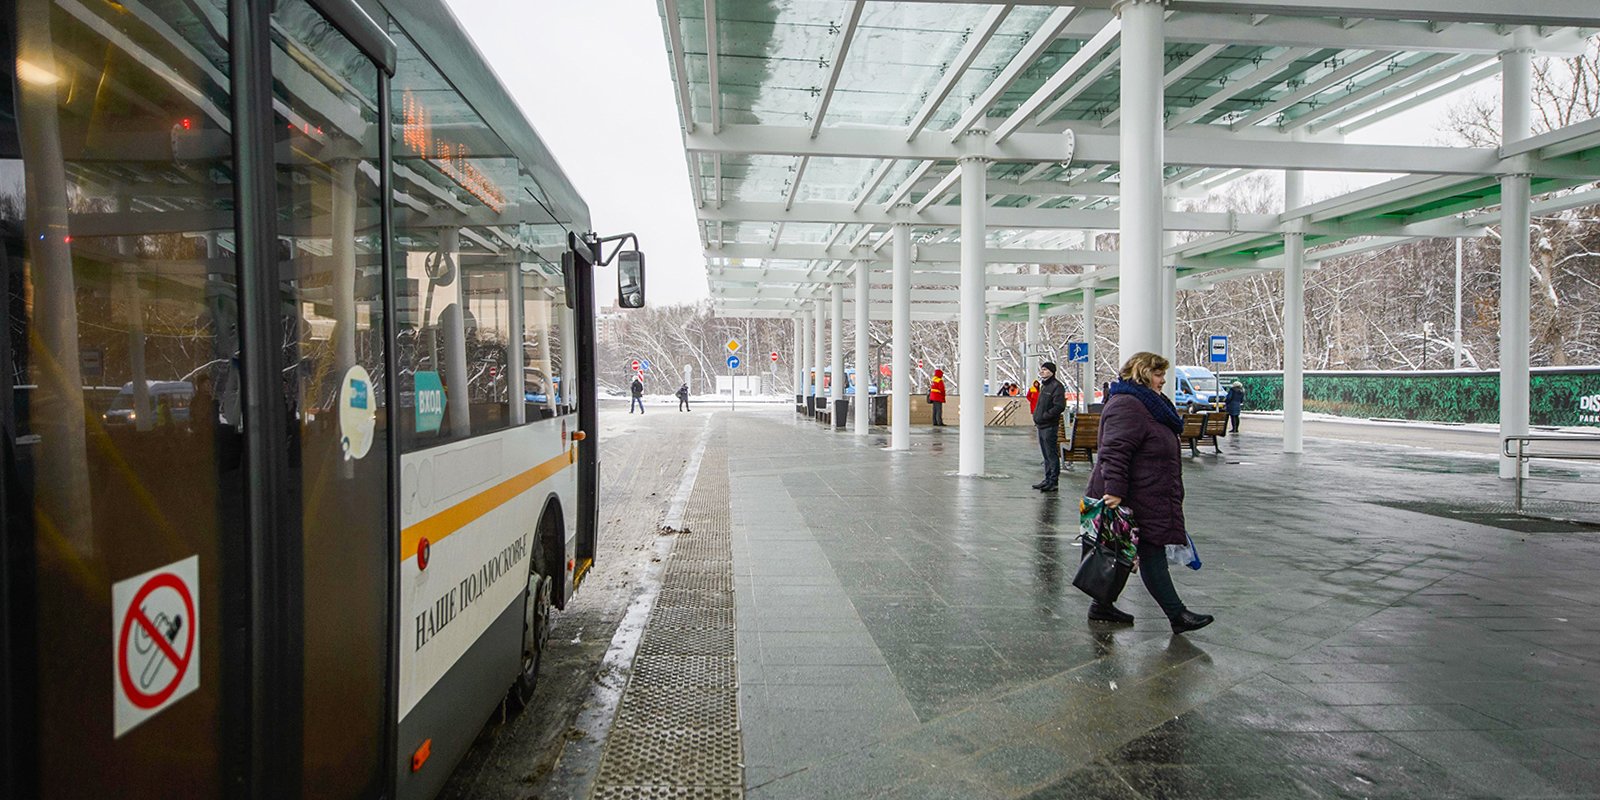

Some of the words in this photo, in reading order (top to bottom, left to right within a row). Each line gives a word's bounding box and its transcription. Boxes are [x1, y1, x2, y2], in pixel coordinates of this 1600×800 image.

[419, 389, 442, 415] ВХОД
[1579, 394, 1600, 413] DIS
[1579, 414, 1600, 423] PARK
[415, 586, 457, 652] НАШЕ
[459, 533, 528, 613] ПОДМОСКОВЬЕ
